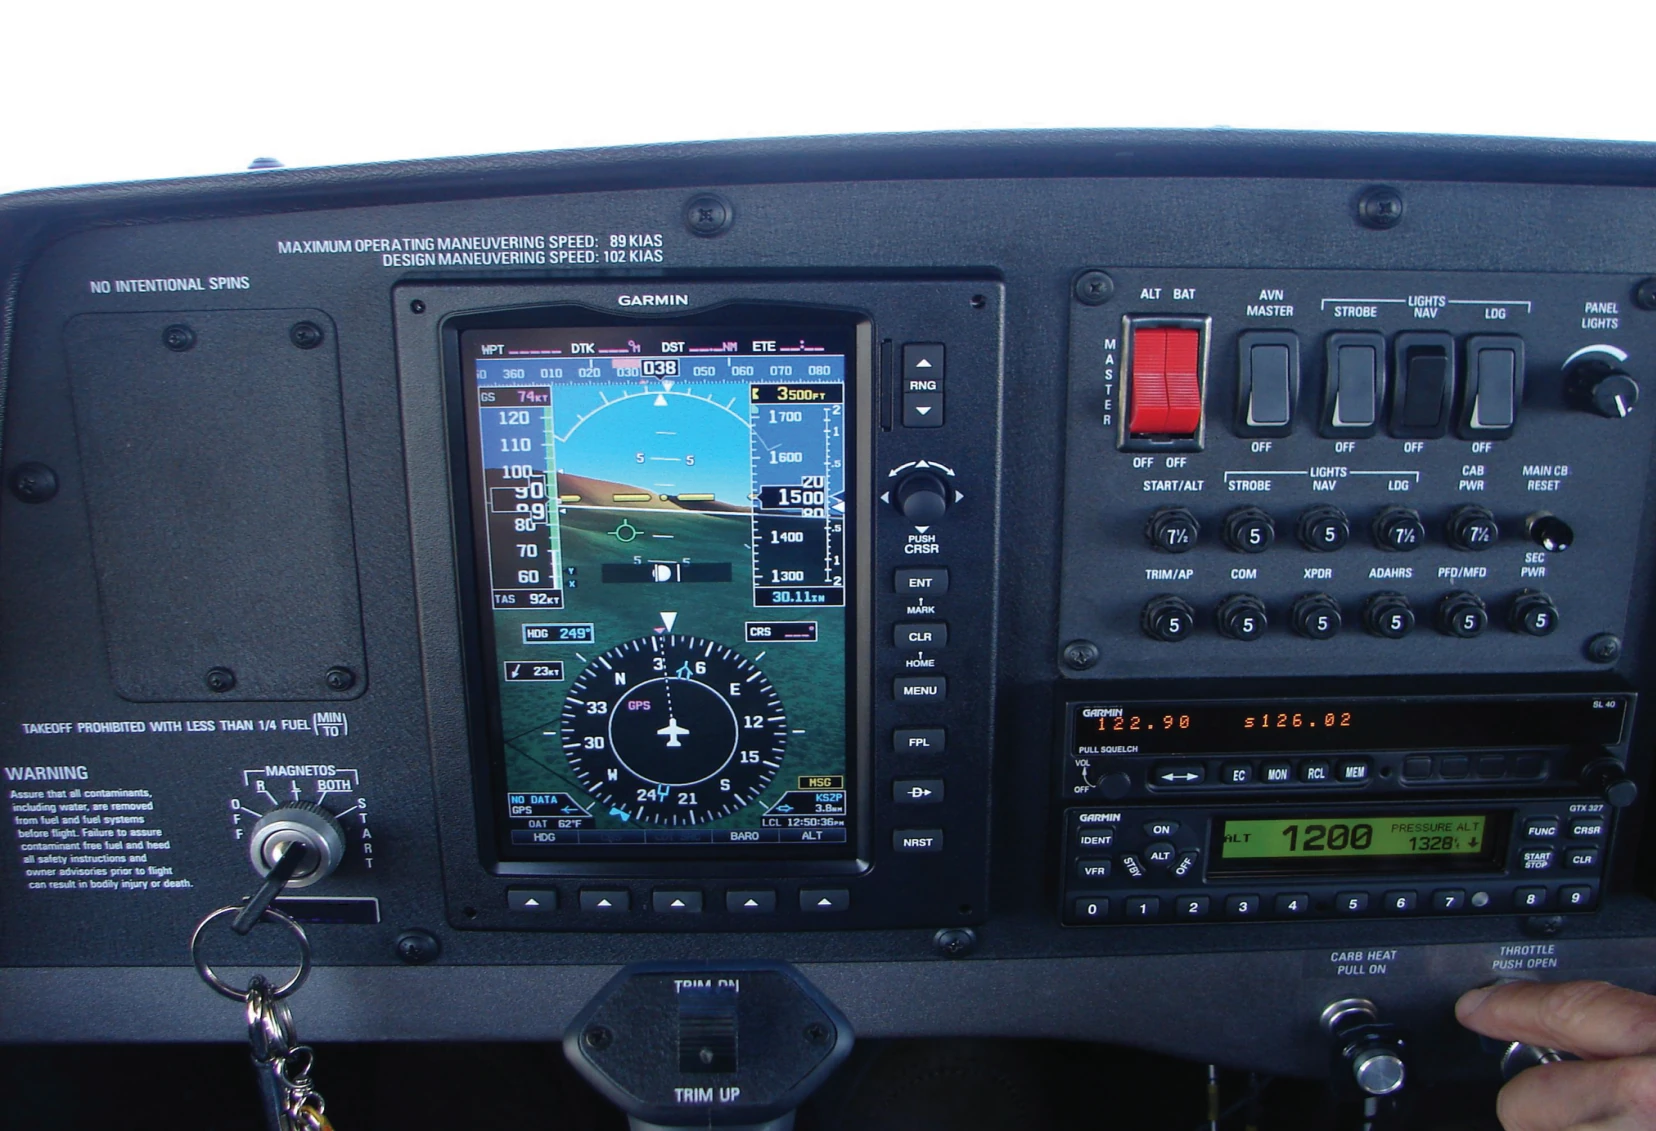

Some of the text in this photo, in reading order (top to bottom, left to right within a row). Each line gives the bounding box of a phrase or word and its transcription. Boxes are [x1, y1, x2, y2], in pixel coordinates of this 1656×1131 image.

[277, 234, 663, 254] MAXIMUM OPERATING MANEUVERING SPEED: 89 KIAS
[382, 250, 664, 267] DESIGN MANEUVERING SPEED: 102 KIAS
[89, 276, 250, 293] NO INTENTIONAL SPINS
[1140, 288, 1196, 299] ALT BAT
[1259, 289, 1284, 300] AVN
[618, 294, 689, 306] GARMIN
[1408, 295, 1446, 307] LIGHTS
[1246, 305, 1294, 317] MASTER
[1334, 306, 1378, 318] STROBE
[1414, 307, 1438, 318] NAV
[1485, 308, 1507, 319] LDG
[1585, 302, 1619, 314] PANEL
[1581, 317, 1619, 329] LIGHTS
[481, 340, 777, 355] WPT DTK DST ETE
[503, 360, 831, 379] 360 010 038 050 060 080
[910, 381, 937, 391] RNG
[480, 392, 495, 402] GS
[499, 411, 530, 425] 120
[769, 409, 802, 424] 1700
[1251, 442, 1272, 452] OFF
[1335, 442, 1356, 453] OFF
[1404, 442, 1424, 453] OFF
[1133, 457, 1187, 468] OFF OFF
[1310, 467, 1348, 478] LIGHTS
[1462, 465, 1485, 476] CAB
[1522, 465, 1569, 476] MAIN CB
[1143, 480, 1205, 491] START/ALT
[1228, 480, 1272, 491] STROBE
[1313, 480, 1337, 491] NAV
[1388, 480, 1410, 491] LDG
[1459, 480, 1485, 491] PWR
[1527, 480, 1561, 491] RESET
[770, 530, 804, 544] 1400
[908, 535, 936, 543] PUSH
[516, 544, 538, 558] 70
[904, 544, 940, 554] CRSR
[1525, 552, 1546, 563] SEC
[518, 570, 539, 583] 60
[1145, 569, 1194, 580] TRIM/AP
[1231, 568, 1257, 579] COM
[1303, 568, 1333, 579] XPDR
[1369, 567, 1413, 579] ADAHRS
[1438, 567, 1487, 578] PFD/MFD
[1521, 567, 1546, 577] PWR
[909, 578, 933, 588] ENT
[494, 594, 516, 604] TAS
[907, 605, 935, 614] MARK
[527, 629, 549, 638] HDG
[750, 627, 772, 637] CRS
[908, 632, 932, 642] CLR
[905, 659, 935, 668] HOME
[903, 686, 938, 695] MENU
[628, 701, 651, 711] GPS
[1082, 707, 1123, 717] GARMIN
[22, 719, 312, 734] TAKEOFF PROHIBITED WITH LESS THAN 1/4 FUEL
[1097, 715, 1191, 731] 122.90
[909, 738, 930, 747] FPL
[1079, 745, 1139, 754] PULL SQUELCH
[5, 766, 89, 781] WARNING
[265, 764, 337, 777] MAGNETOS
[1232, 766, 1365, 782] EC MON MEM
[317, 779, 351, 790] BOTH
[809, 778, 832, 787] MSG
[10, 788, 153, 799] Assure that all contaminants,
[511, 795, 558, 804] NO DATA
[12, 801, 154, 814] including water, are removed
[512, 806, 533, 815] GPS
[1569, 804, 1604, 812] GTX 327
[14, 815, 146, 826] from fuel and fuel systems
[762, 818, 782, 827] LCL
[1079, 813, 1121, 823] GARMIN
[528, 820, 548, 828] OAT
[1391, 822, 1480, 833] PRESSURE ALT
[17, 829, 49, 838] before
[82, 828, 114, 837] Failure
[130, 828, 163, 837] assure
[1153, 825, 1170, 835] ON
[1528, 827, 1556, 836] FUNC
[1573, 826, 1601, 835] CRSR
[533, 833, 556, 842] HDG
[730, 831, 823, 841] BARO ALT
[1080, 836, 1112, 845] IDENT
[1224, 833, 1252, 844] ALT
[1282, 823, 1373, 852] 1200
[903, 837, 933, 847] NRST
[1150, 851, 1171, 861] ALT
[1524, 852, 1551, 861] START
[1572, 855, 1592, 864] CLR
[1524, 861, 1549, 869] STOP
[1084, 866, 1105, 876] VFR
[1499, 944, 1556, 956] THROTTLE
[1330, 950, 1398, 962] CARB HEAT
[1337, 964, 1387, 975] PULL ON
[1492, 958, 1558, 970] PUSH OPEN
[674, 1086, 741, 1102] TRIM UP
